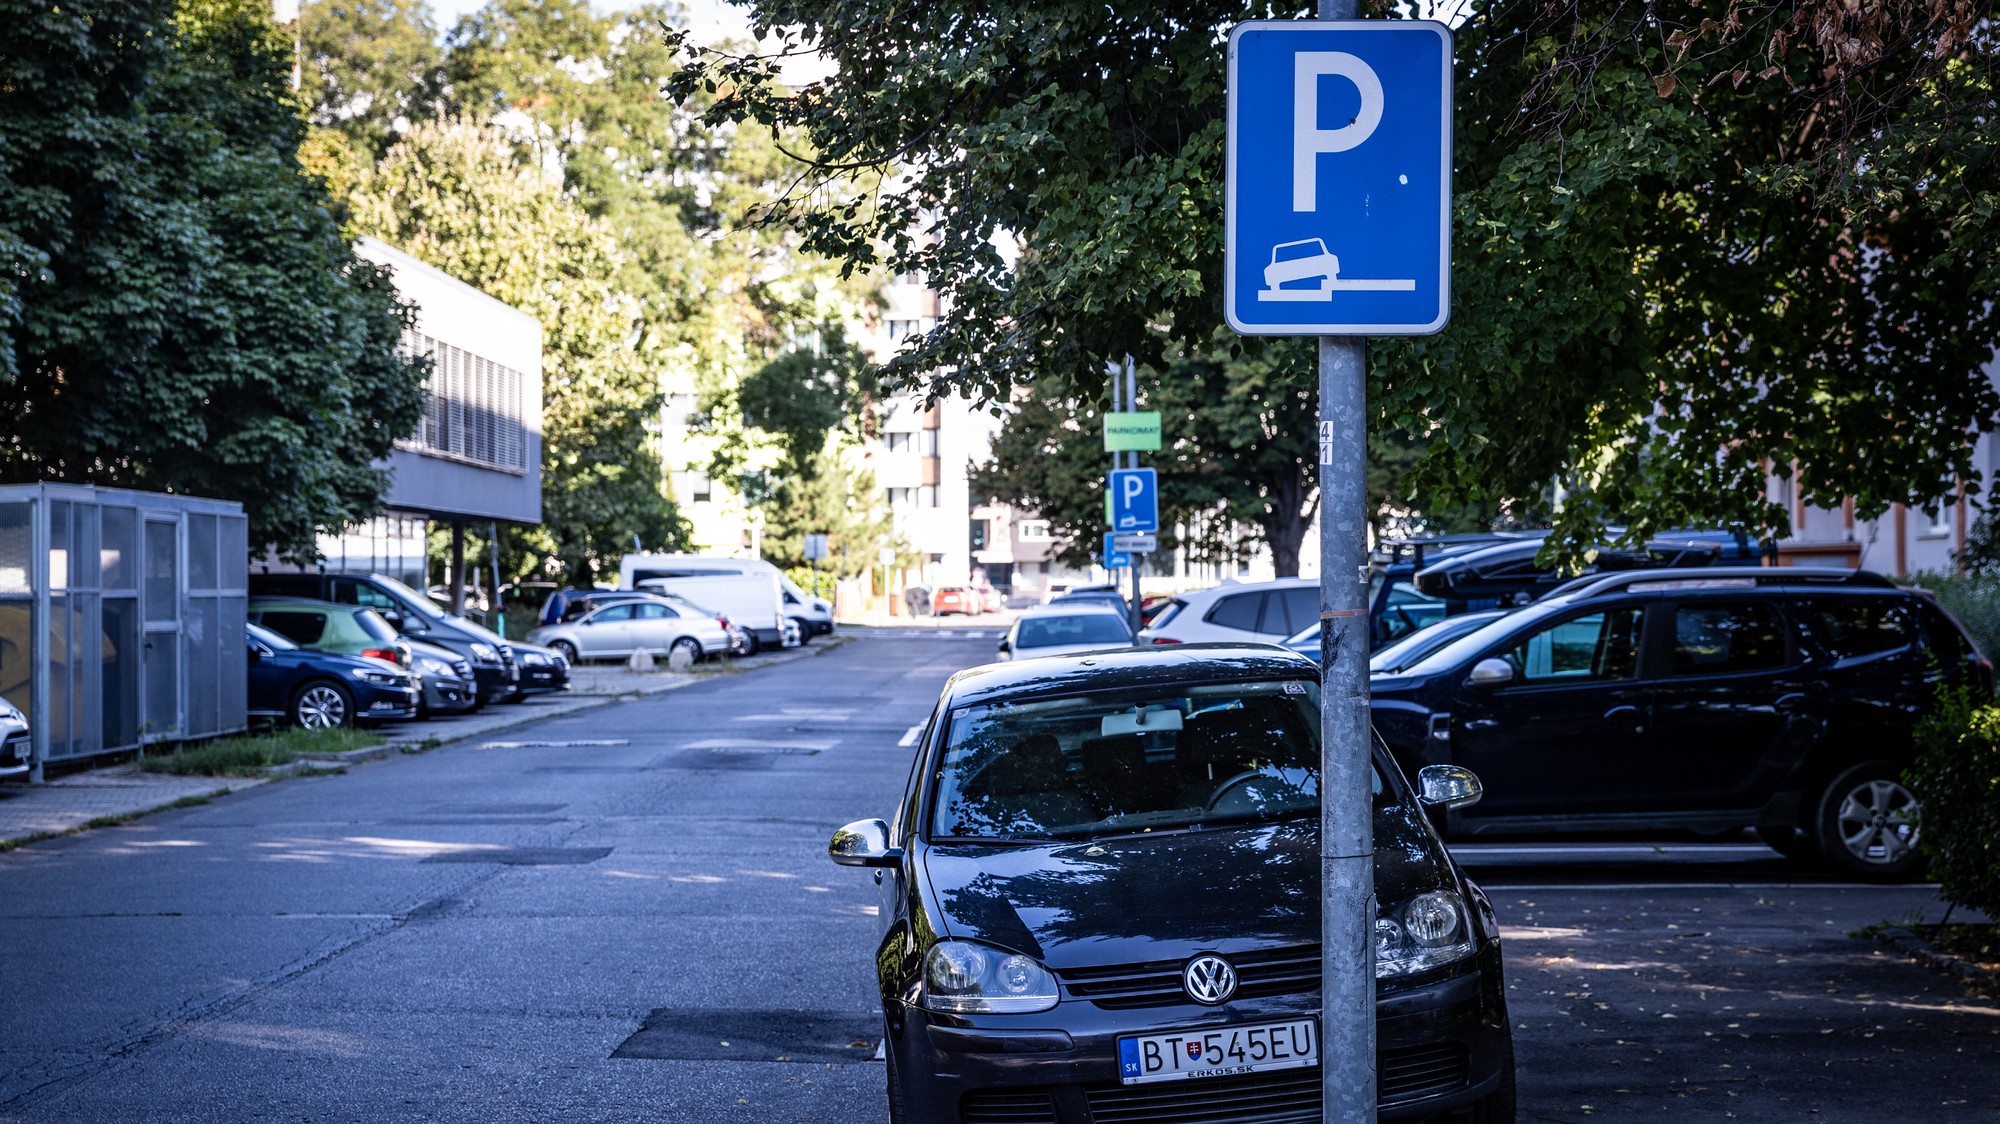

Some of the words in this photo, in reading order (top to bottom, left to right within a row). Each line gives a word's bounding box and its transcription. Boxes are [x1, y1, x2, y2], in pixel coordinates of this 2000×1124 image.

[1293, 51, 1384, 212] P
[1107, 427, 1159, 435] PARKOMAT
[1321, 422, 1330, 441] 4
[1123, 475, 1144, 509] P
[1125, 1062, 1138, 1072] SK
[1187, 1065, 1254, 1078] ERKOS.SK
